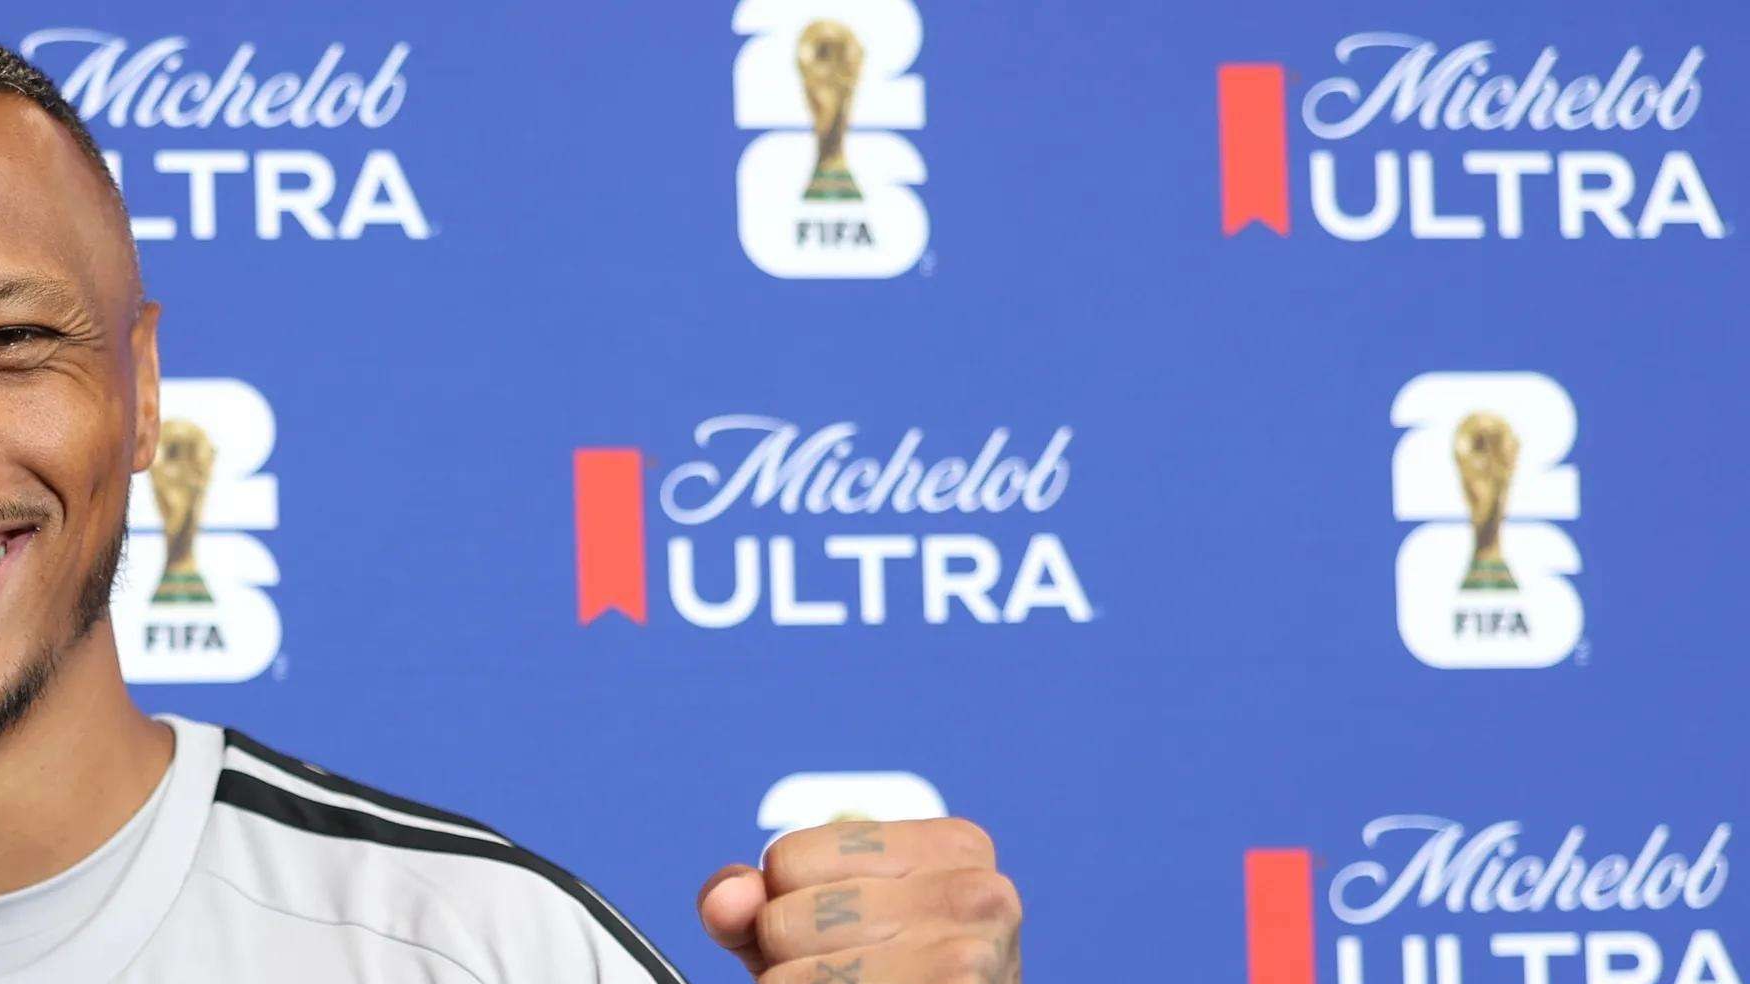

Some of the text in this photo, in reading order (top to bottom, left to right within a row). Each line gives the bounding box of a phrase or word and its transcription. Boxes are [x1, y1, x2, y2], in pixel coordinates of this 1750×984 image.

[19, 28, 412, 130] Michelob
[1300, 32, 1706, 140] Michelob
[105, 148, 434, 242] LTRA
[795, 218, 876, 250] FIFA
[1308, 149, 1726, 242] ULTRA
[658, 413, 1074, 526] Michelob
[666, 532, 1094, 629] ULTRA
[1453, 607, 1531, 640] FIFA
[143, 622, 226, 655] FIFA
[1327, 813, 1733, 926] Michelob
